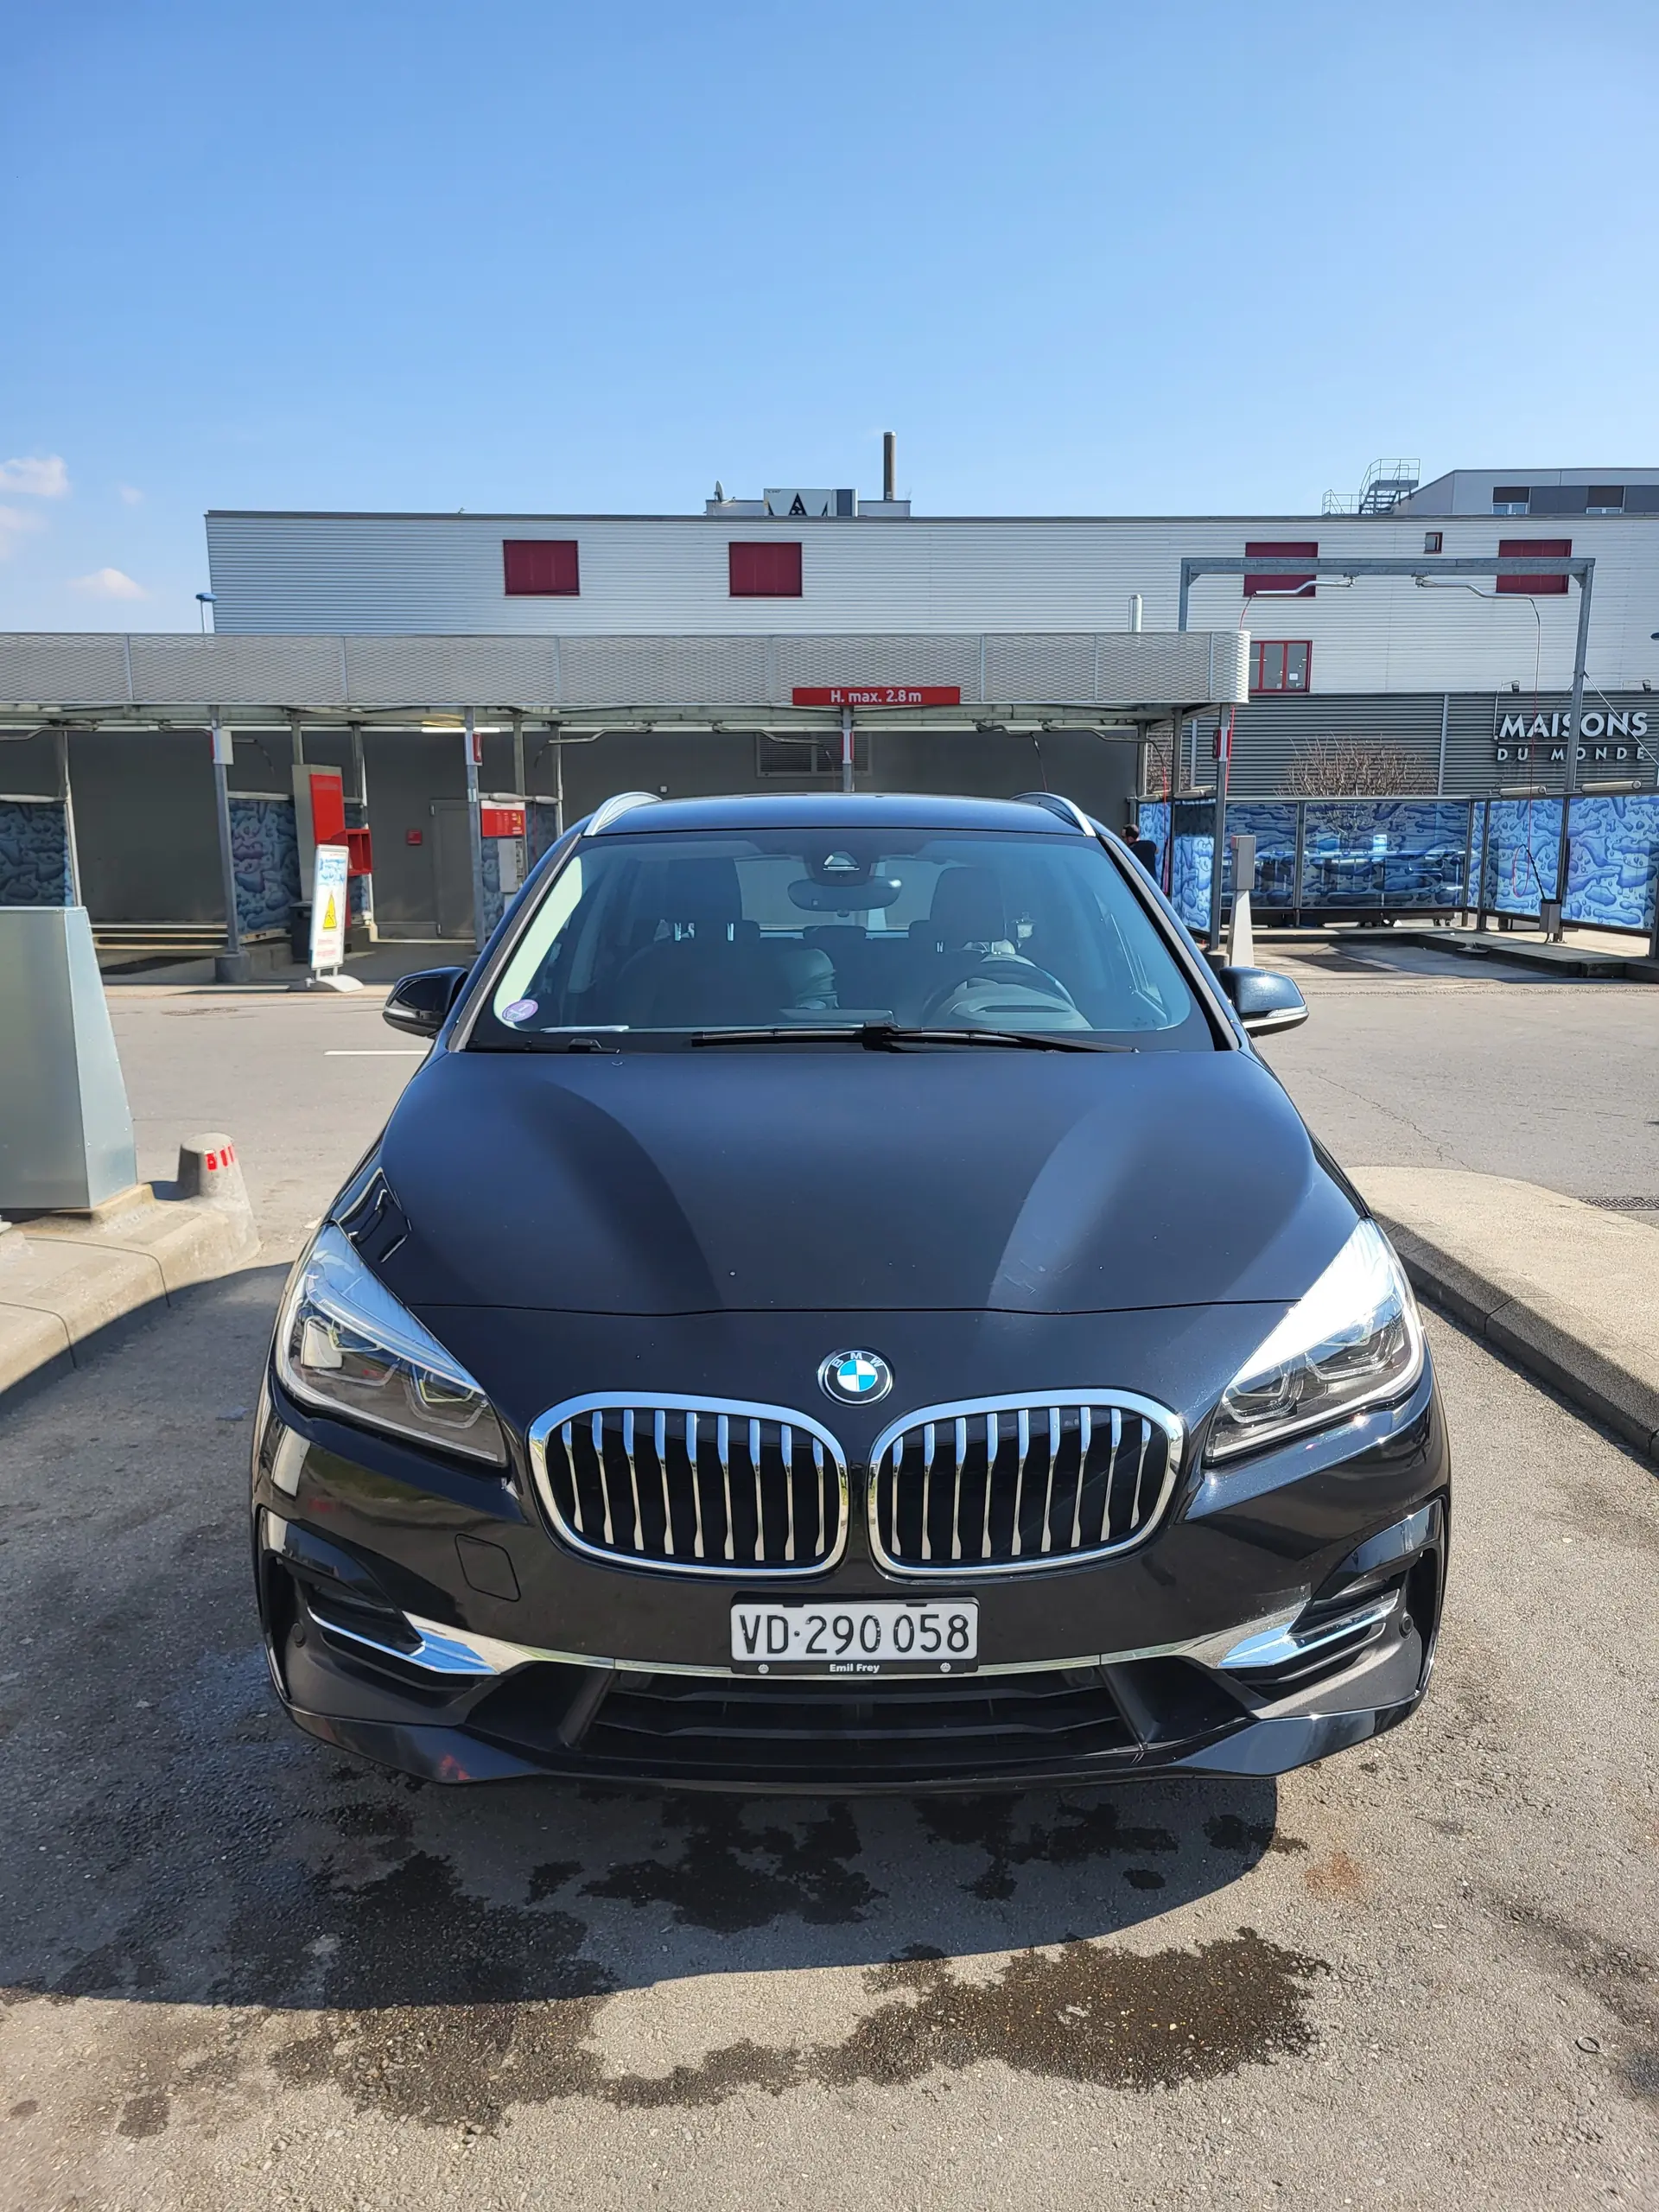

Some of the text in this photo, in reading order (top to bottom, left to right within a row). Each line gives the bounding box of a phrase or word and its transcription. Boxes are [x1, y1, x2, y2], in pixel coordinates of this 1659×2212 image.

[830, 690, 845, 702] H.
[848, 692, 882, 702] max.
[1498, 712, 1648, 738] MAISONS
[1497, 747, 1645, 761] DU MONDE
[831, 1352, 883, 1369] BMW
[830, 1663, 880, 1674] Emil Frey
